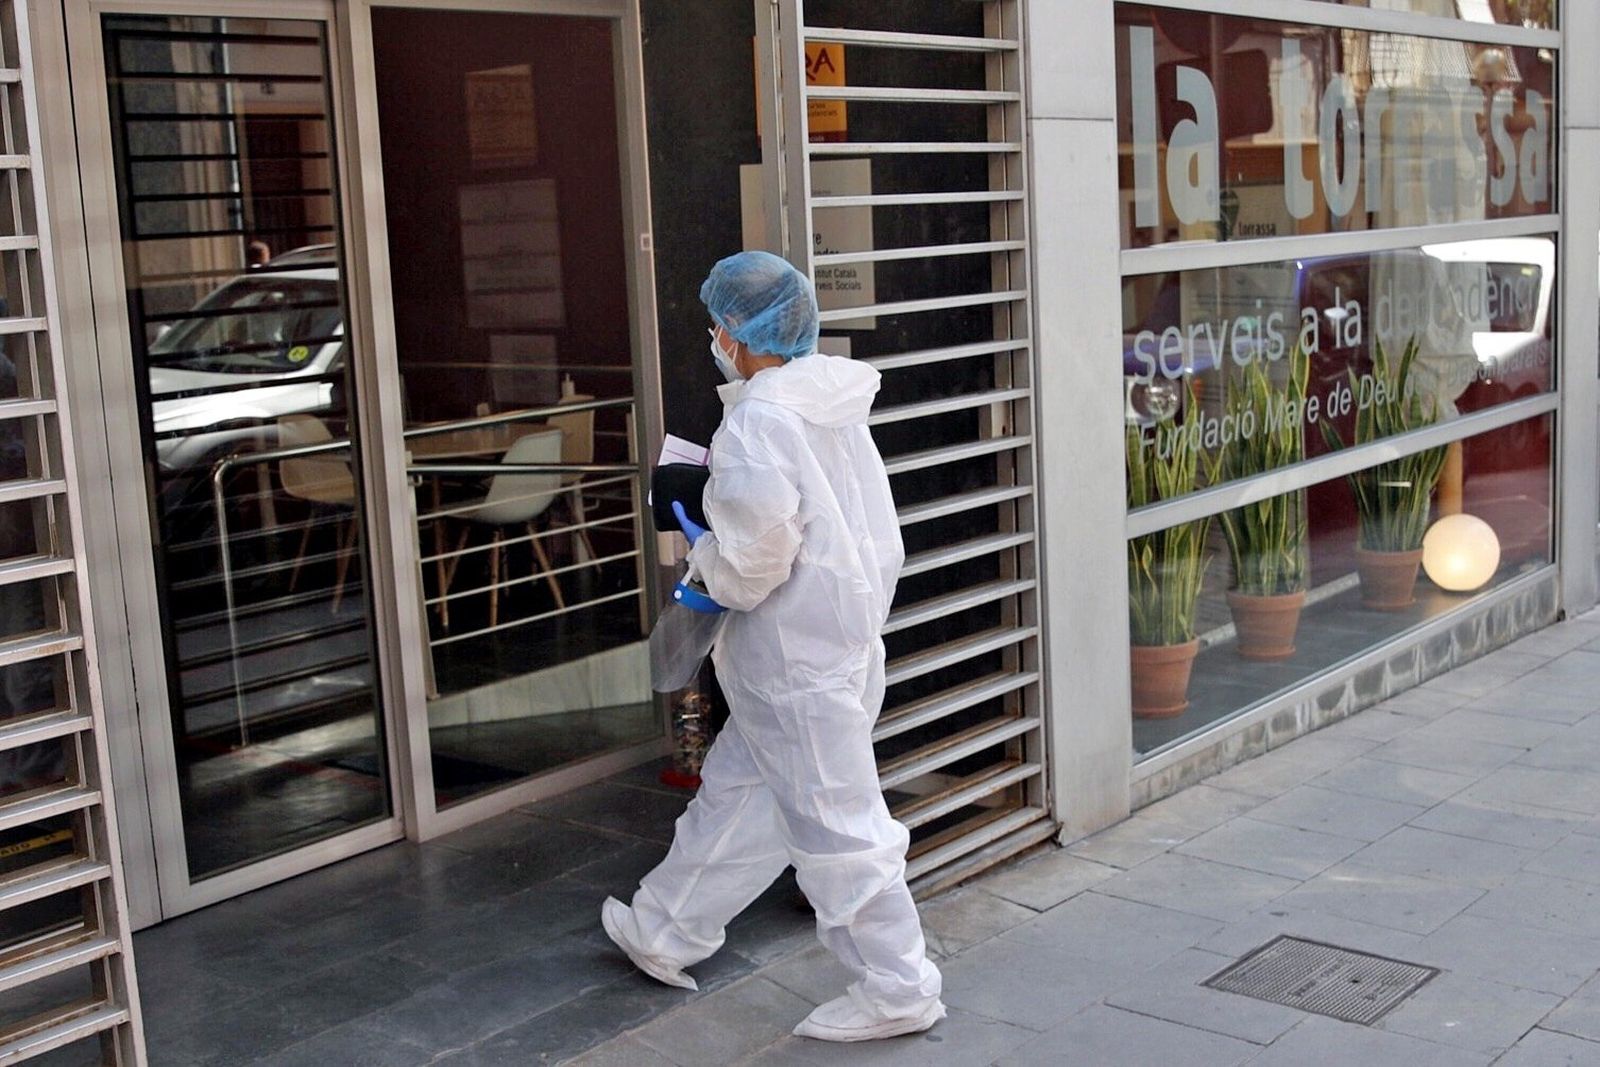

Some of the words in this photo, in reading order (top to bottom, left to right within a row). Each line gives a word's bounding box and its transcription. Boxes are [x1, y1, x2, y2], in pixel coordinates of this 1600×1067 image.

[1130, 25, 1220, 227] la
[1133, 300, 1285, 385] serveis
[1301, 306, 1319, 356] a
[1335, 286, 1362, 349] la
[1139, 401, 1255, 460] Fundació
[1263, 394, 1320, 435] Mare
[1326, 381, 1351, 419] de
[1358, 372, 1398, 411] Déu
